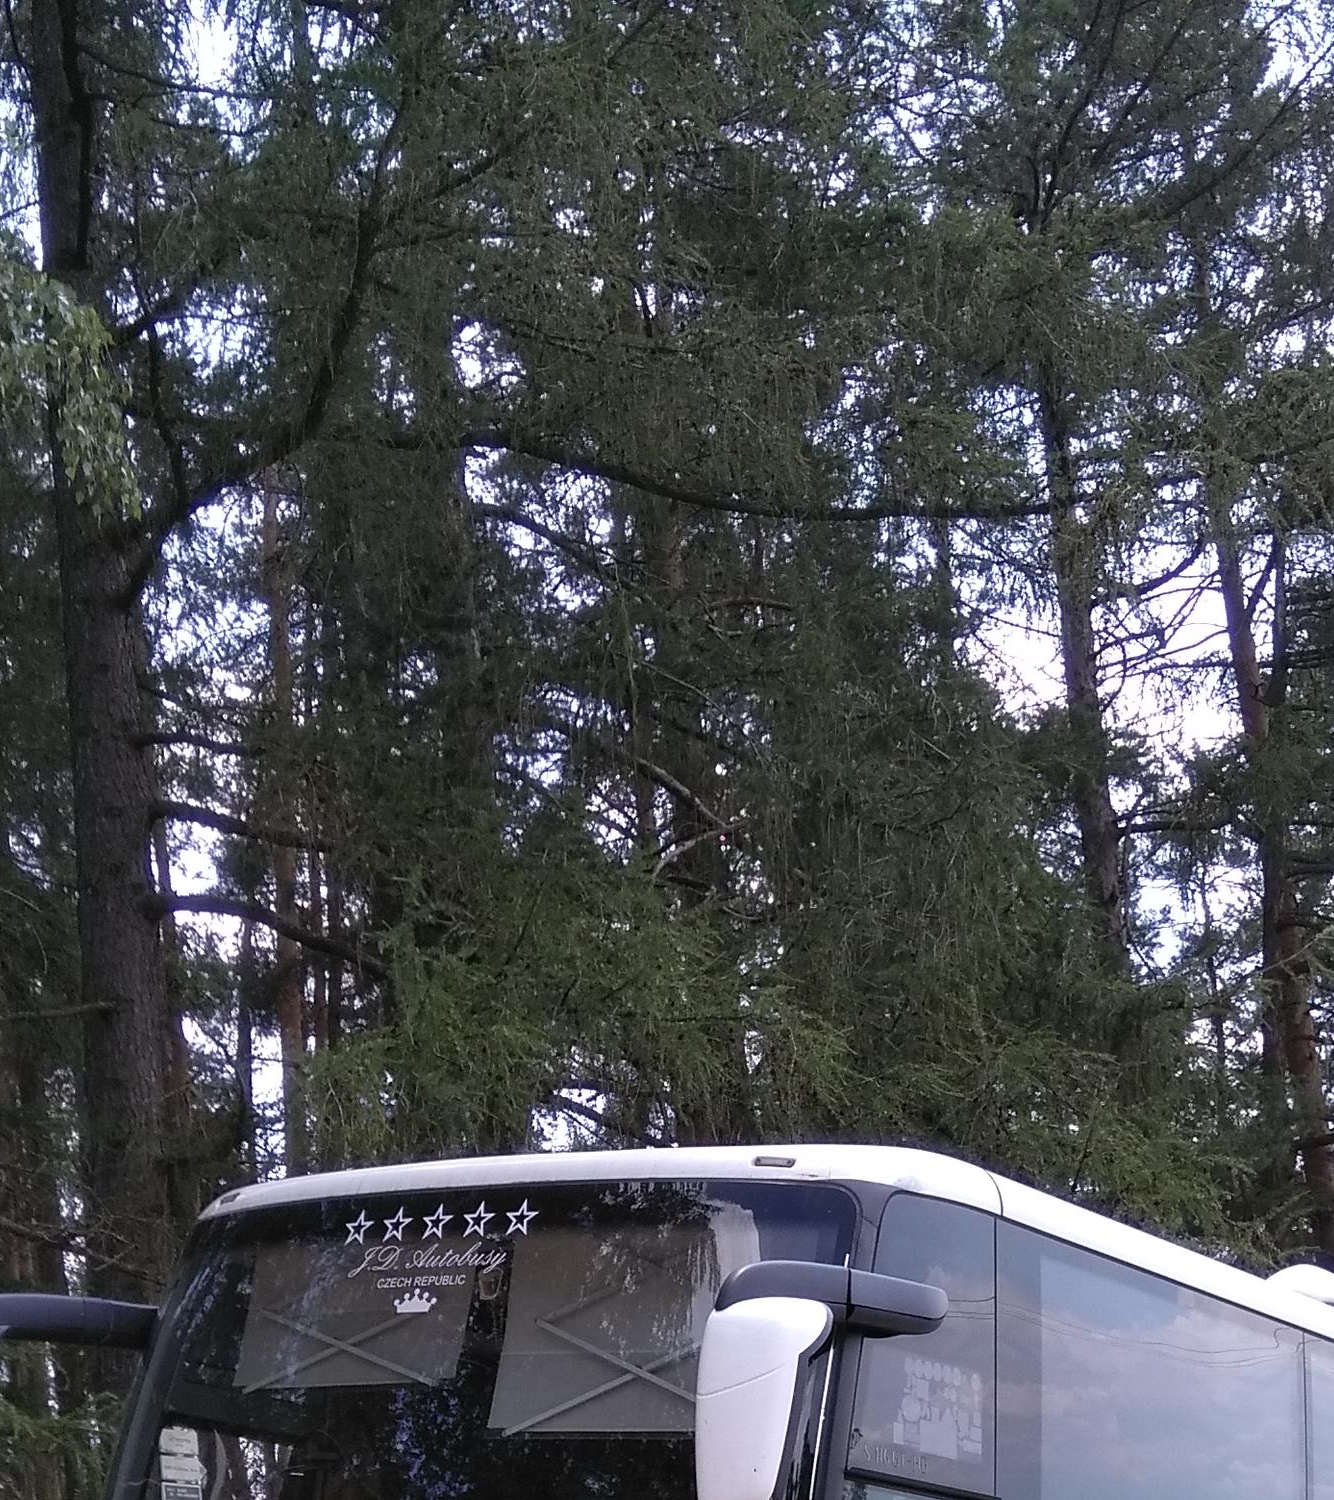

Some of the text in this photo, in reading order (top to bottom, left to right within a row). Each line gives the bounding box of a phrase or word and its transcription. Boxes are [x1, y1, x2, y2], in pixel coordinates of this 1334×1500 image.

[406, 1241, 508, 1274] Autobusy
[377, 1274, 467, 1289] CZECH REPUBLIC
